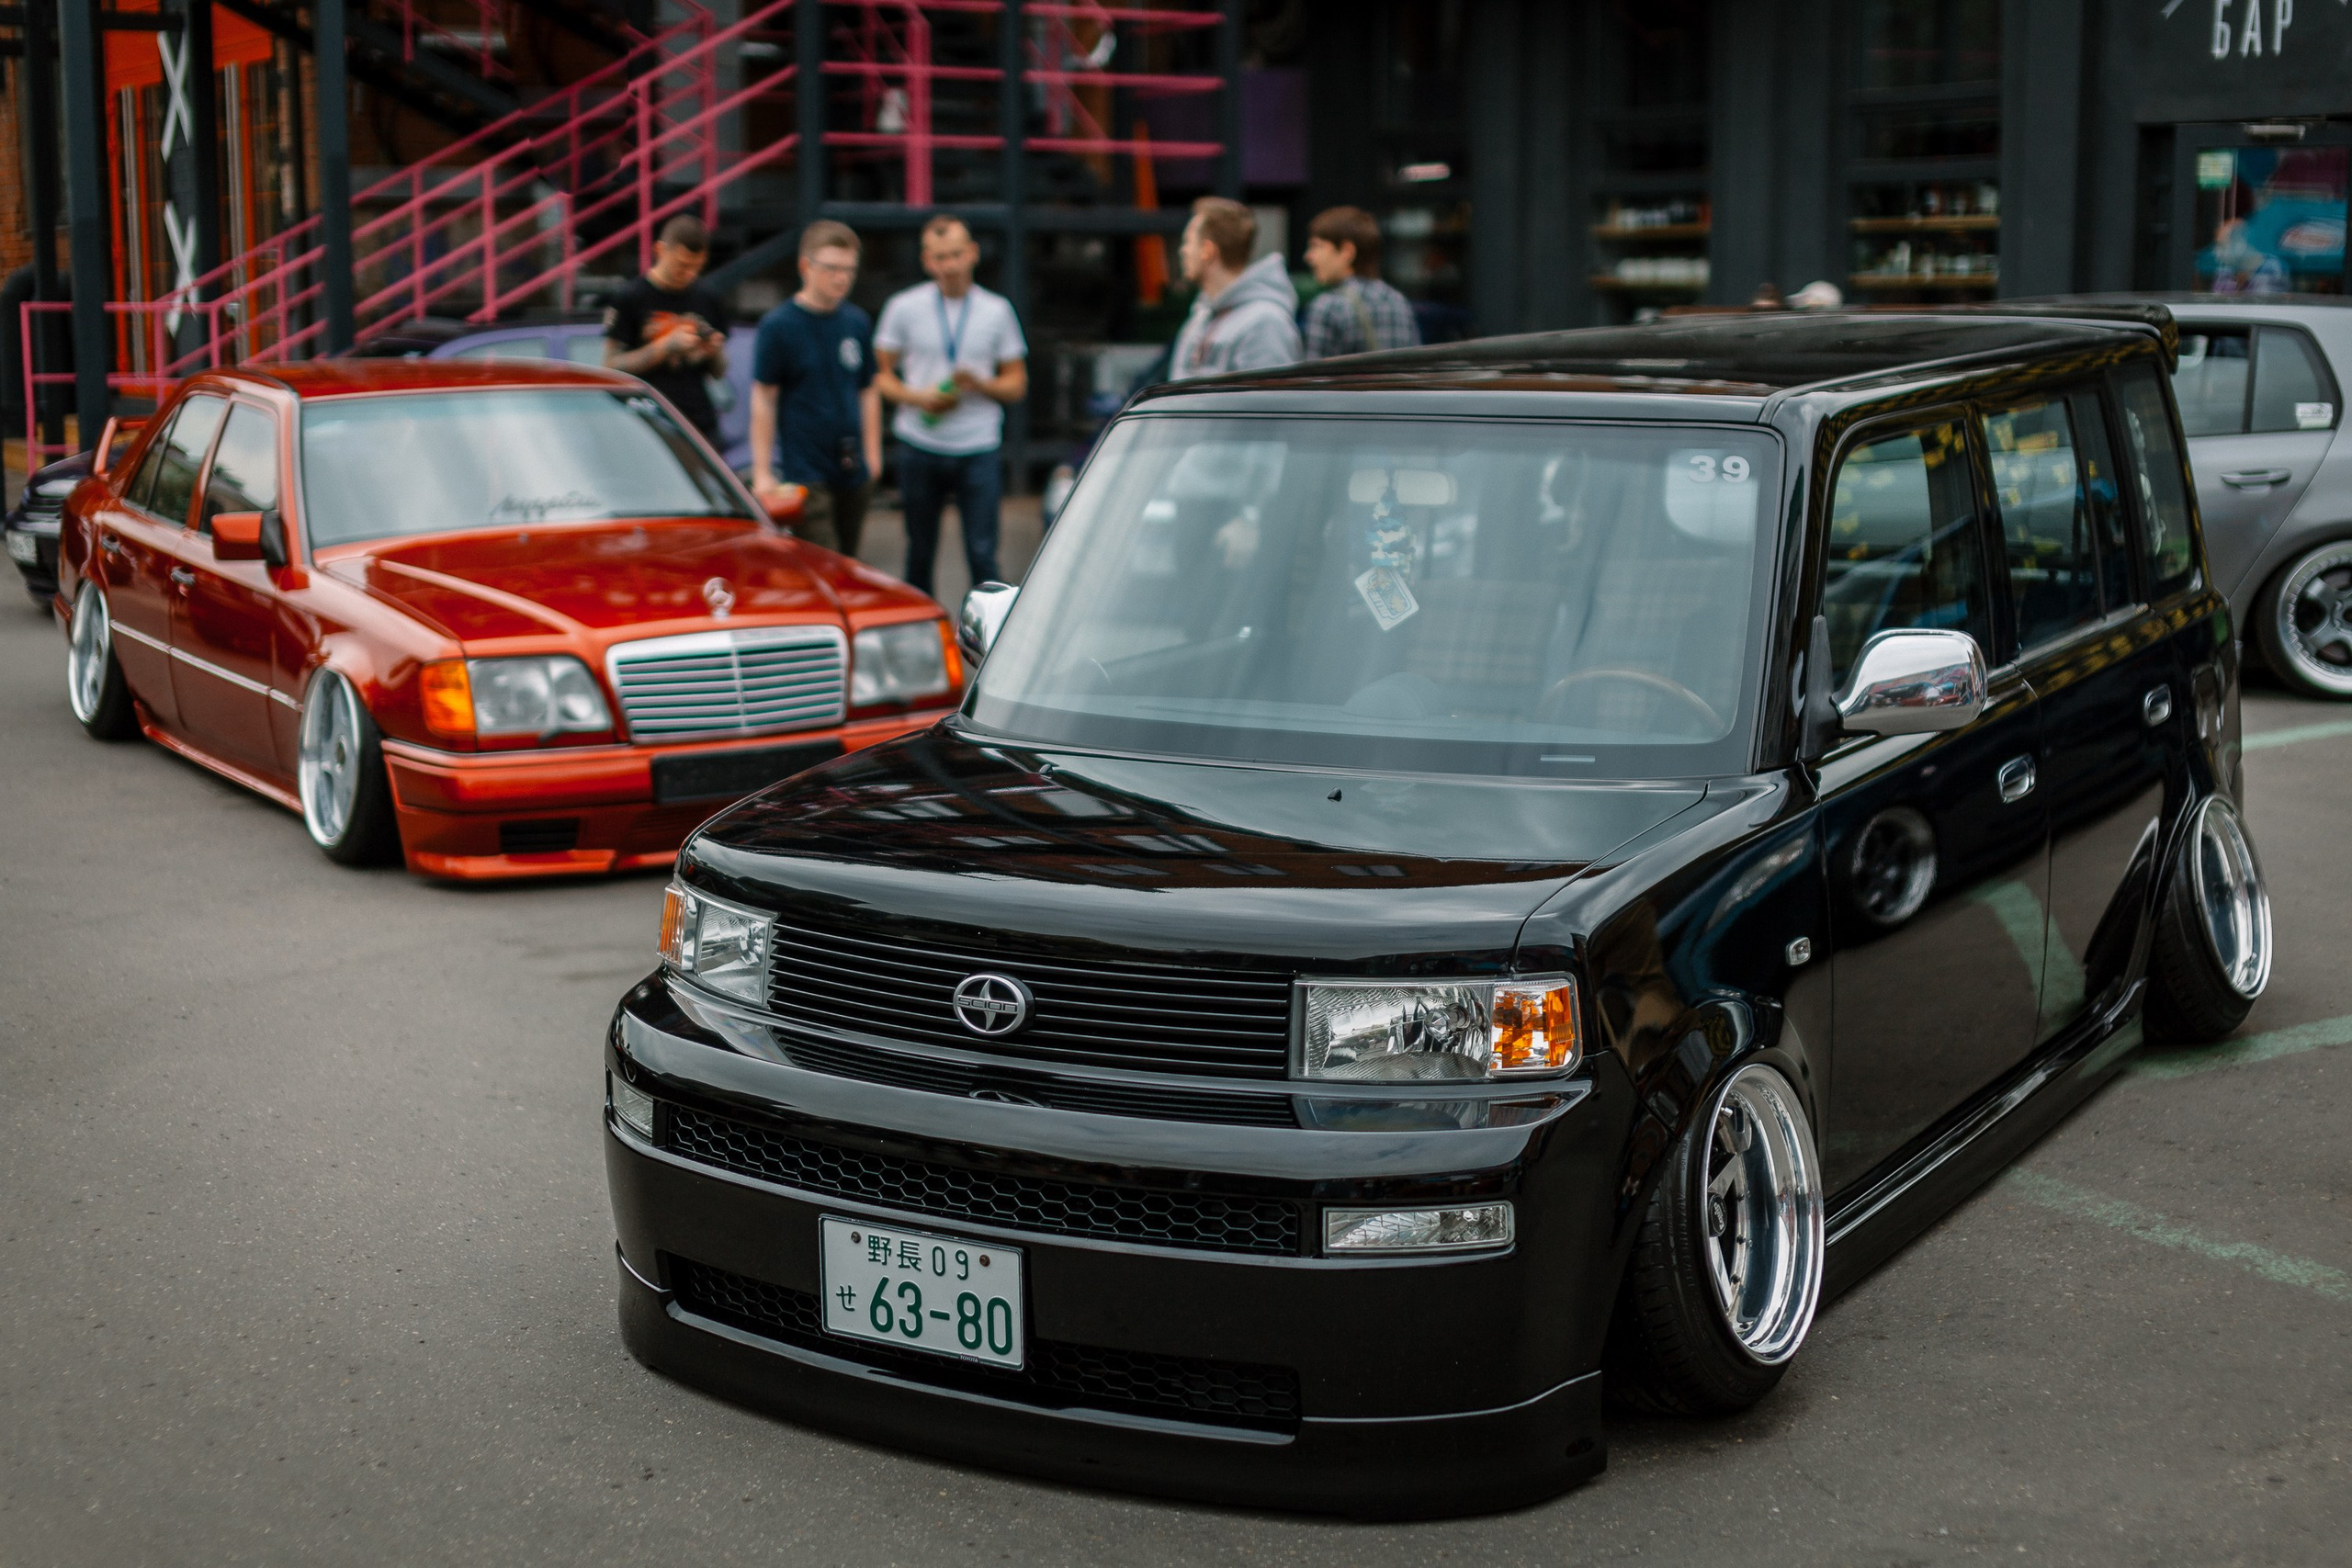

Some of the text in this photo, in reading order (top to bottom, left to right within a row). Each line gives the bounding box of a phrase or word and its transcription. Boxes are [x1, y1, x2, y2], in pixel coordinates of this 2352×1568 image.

[2211, 0, 2294, 60] БАР
[1689, 454, 1750, 483] 39
[869, 1276, 1013, 1356] 63-80
[959, 1354, 979, 1363] TOYOTA
